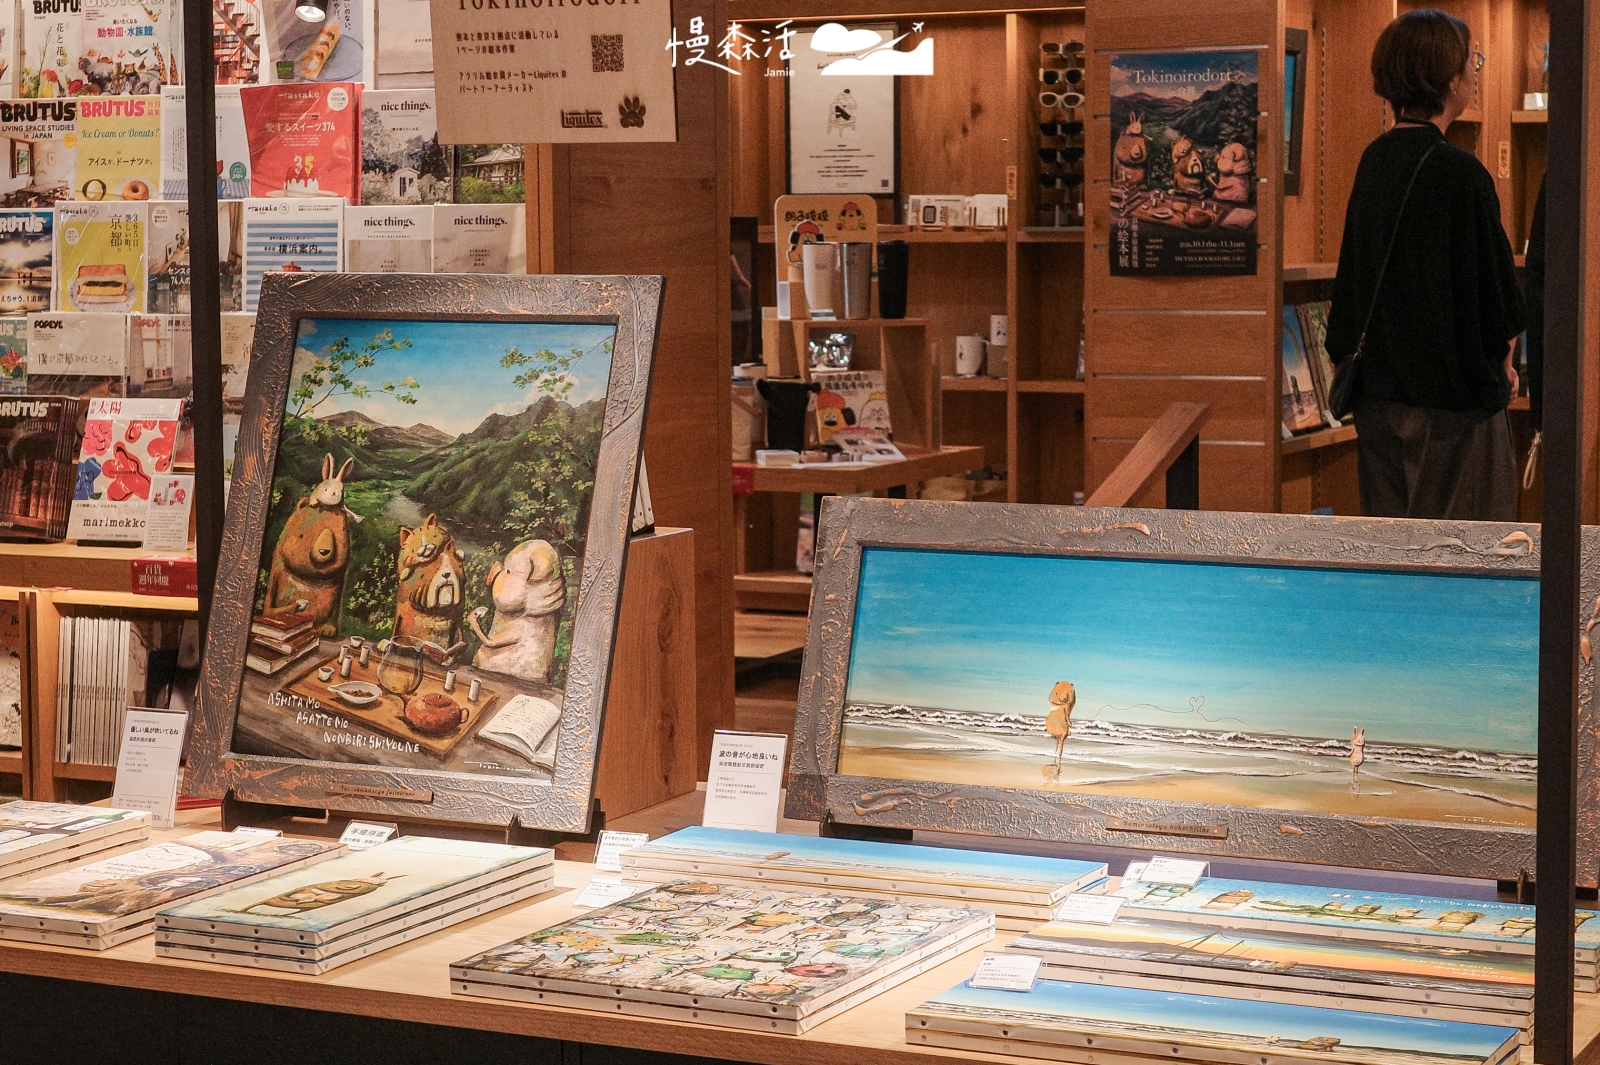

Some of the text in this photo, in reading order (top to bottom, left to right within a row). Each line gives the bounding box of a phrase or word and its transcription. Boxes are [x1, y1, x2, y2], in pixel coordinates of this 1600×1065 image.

[1133, 68, 1231, 84] Tokinoirodori
[0, 100, 76, 123] BRUTUS
[81, 99, 146, 118] BRUTUS
[381, 100, 432, 115] nice things.
[561, 109, 603, 128] Liquitex
[25, 124, 46, 132] SPACE
[48, 124, 75, 132] STUDIES
[82, 129, 92, 138] Ice
[94, 129, 117, 138] Cream
[128, 128, 160, 138] Donuts?
[364, 216, 416, 229] nice things.
[454, 215, 508, 228] nice things.
[33, 320, 63, 329] POPEYE
[0, 400, 49, 417] RUTUS
[97, 400, 122, 415] 太陽
[82, 518, 146, 528] marimekko
[267, 692, 303, 708] ASHITA
[296, 711, 332, 727] ASATTE
[719, 750, 779, 761] 波の音が心地良いね
